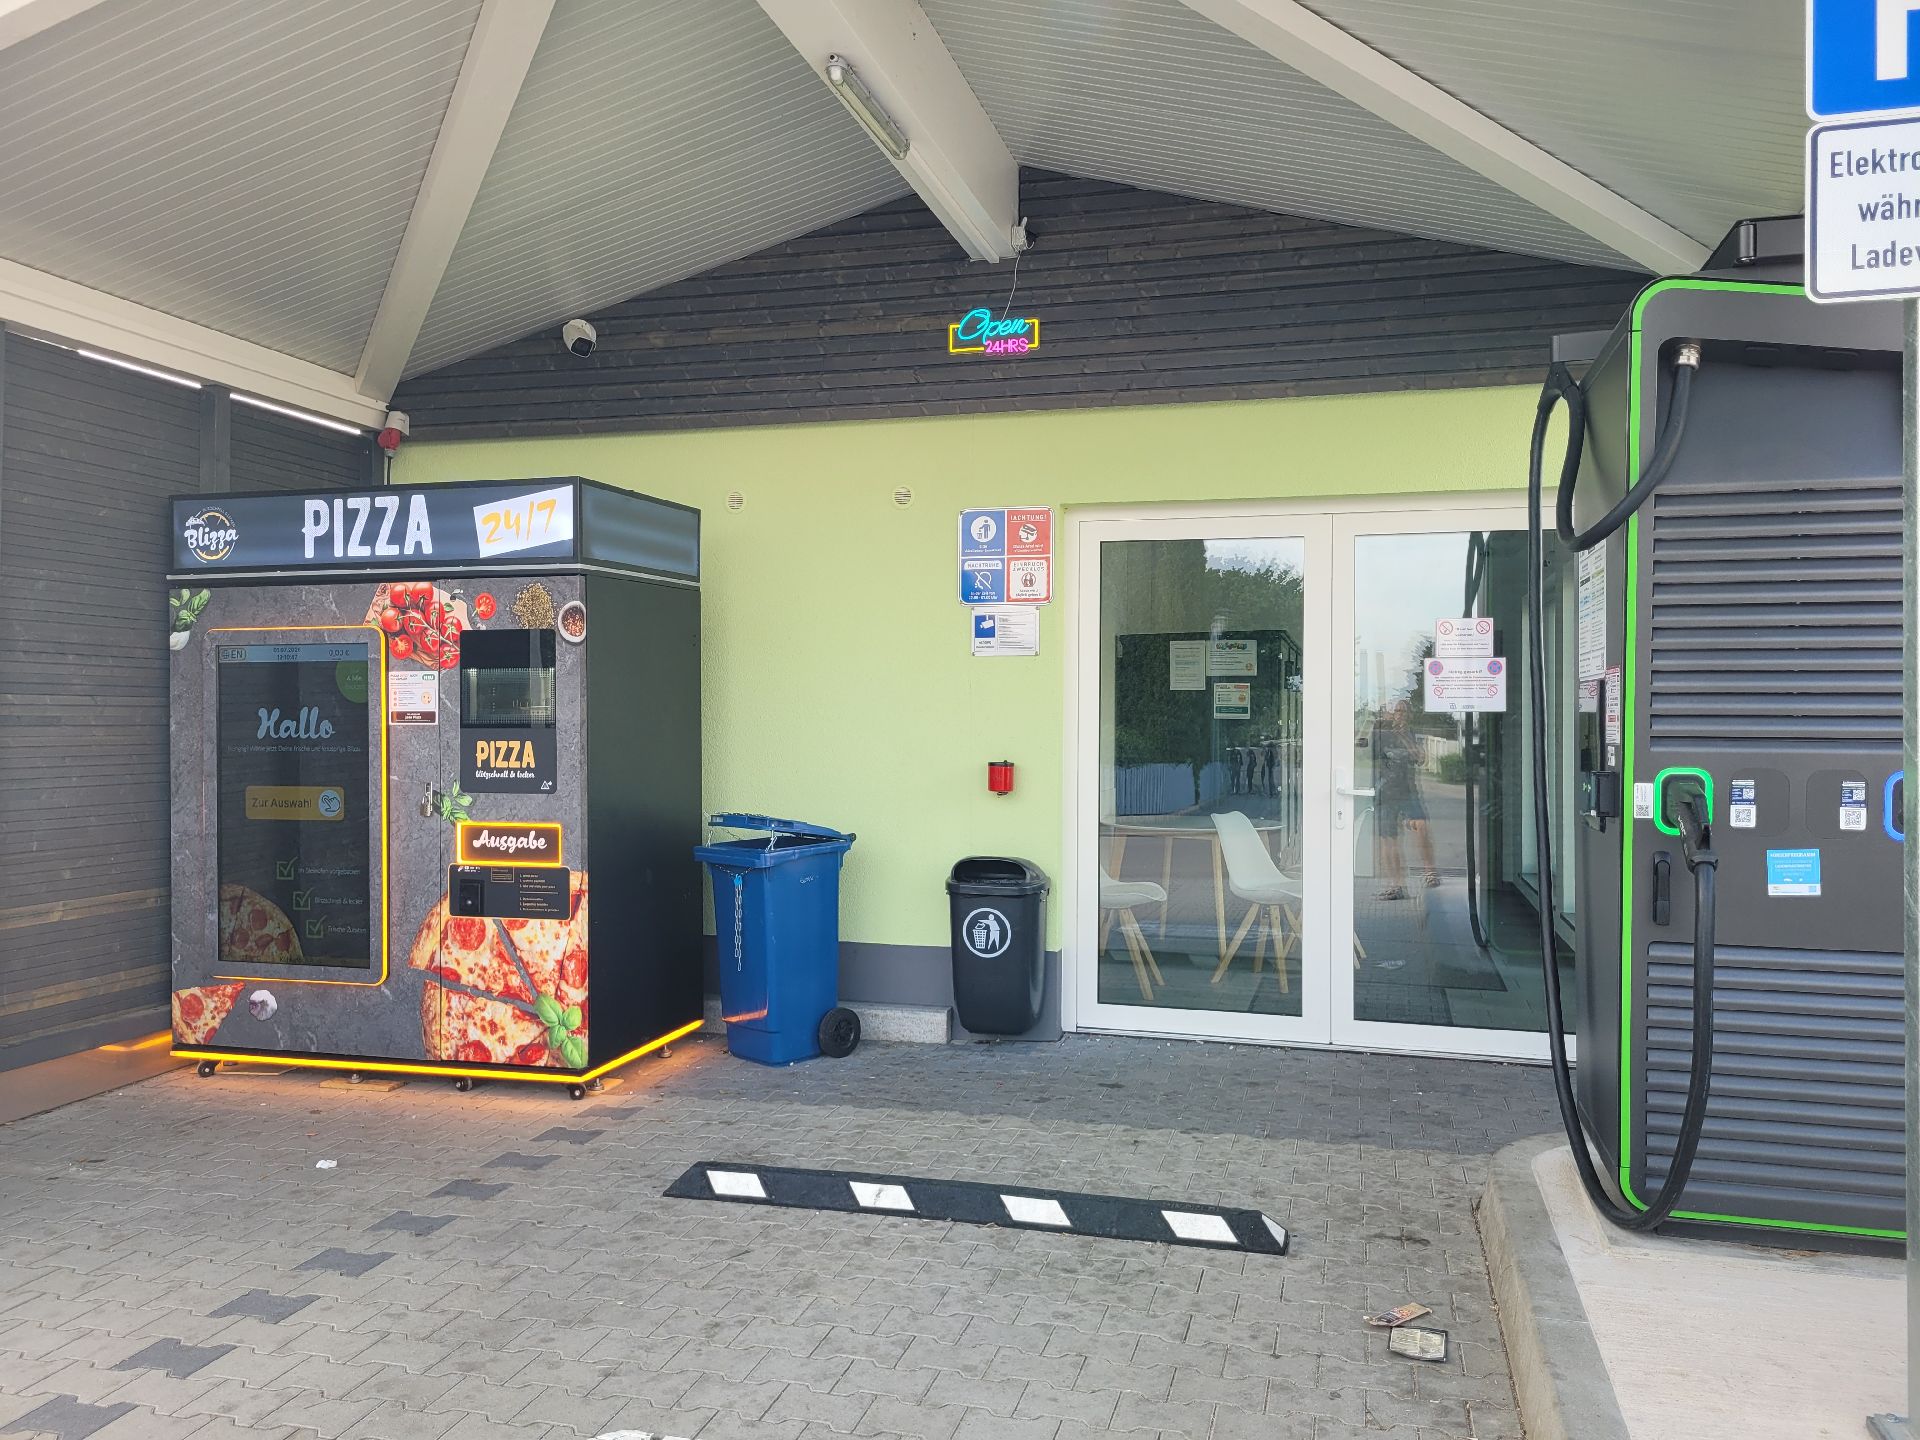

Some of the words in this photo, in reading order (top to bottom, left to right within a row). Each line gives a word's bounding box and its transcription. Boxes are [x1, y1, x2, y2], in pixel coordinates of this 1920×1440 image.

[957, 308, 1030, 344] Open
[984, 338, 1029, 353] 24HRS
[301, 494, 433, 559] PIZZA
[481, 498, 557, 544] 24/7
[184, 526, 239, 550] Blizza
[231, 649, 243, 659] EN
[257, 706, 336, 740] Hallo
[475, 740, 536, 769] PIZZA
[252, 798, 268, 809] Zur
[270, 798, 312, 809] Auswahl
[473, 829, 547, 853] Ausgabe
